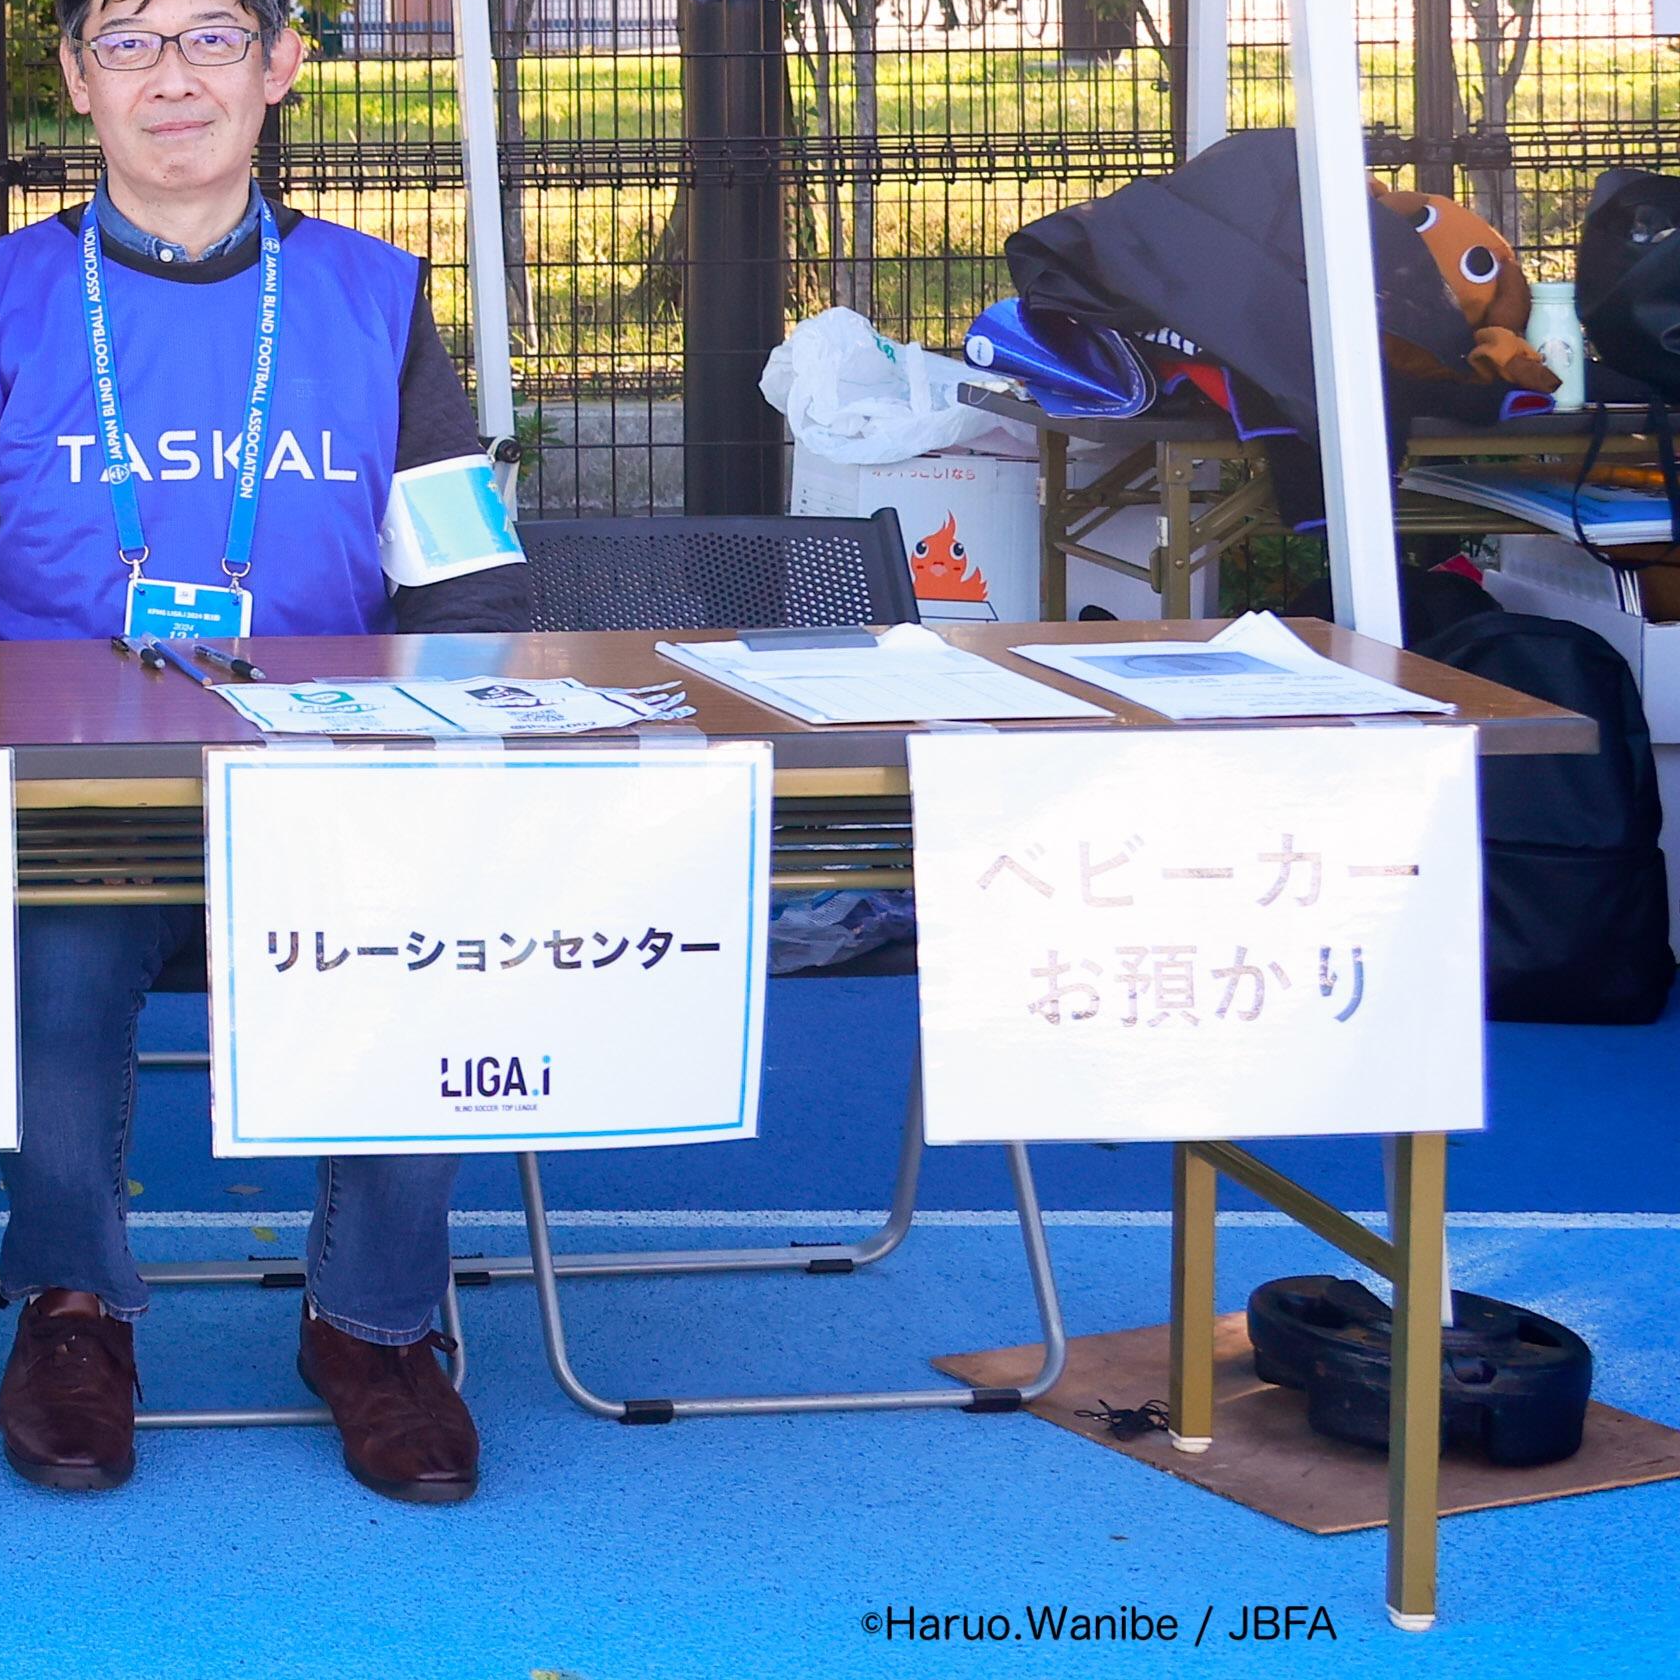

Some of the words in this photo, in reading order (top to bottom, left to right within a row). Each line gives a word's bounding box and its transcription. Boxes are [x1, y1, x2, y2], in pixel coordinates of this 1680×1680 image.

[83, 225, 102, 303] ASSOCIATION
[264, 254, 278, 292] JAPAN
[90, 305, 109, 374] FOOTBALL
[260, 294, 276, 333] BLIND
[99, 378, 116, 417] BLIND
[251, 335, 273, 404] FOOTBALL
[57, 430, 357, 482] TASKAL
[104, 419, 123, 461] JAPAN
[240, 406, 263, 499] ASSOCIATION
[976, 833, 1420, 908] ベビーカー
[266, 926, 722, 973] リレーションセンター
[1028, 945, 1365, 1028] お預かり
